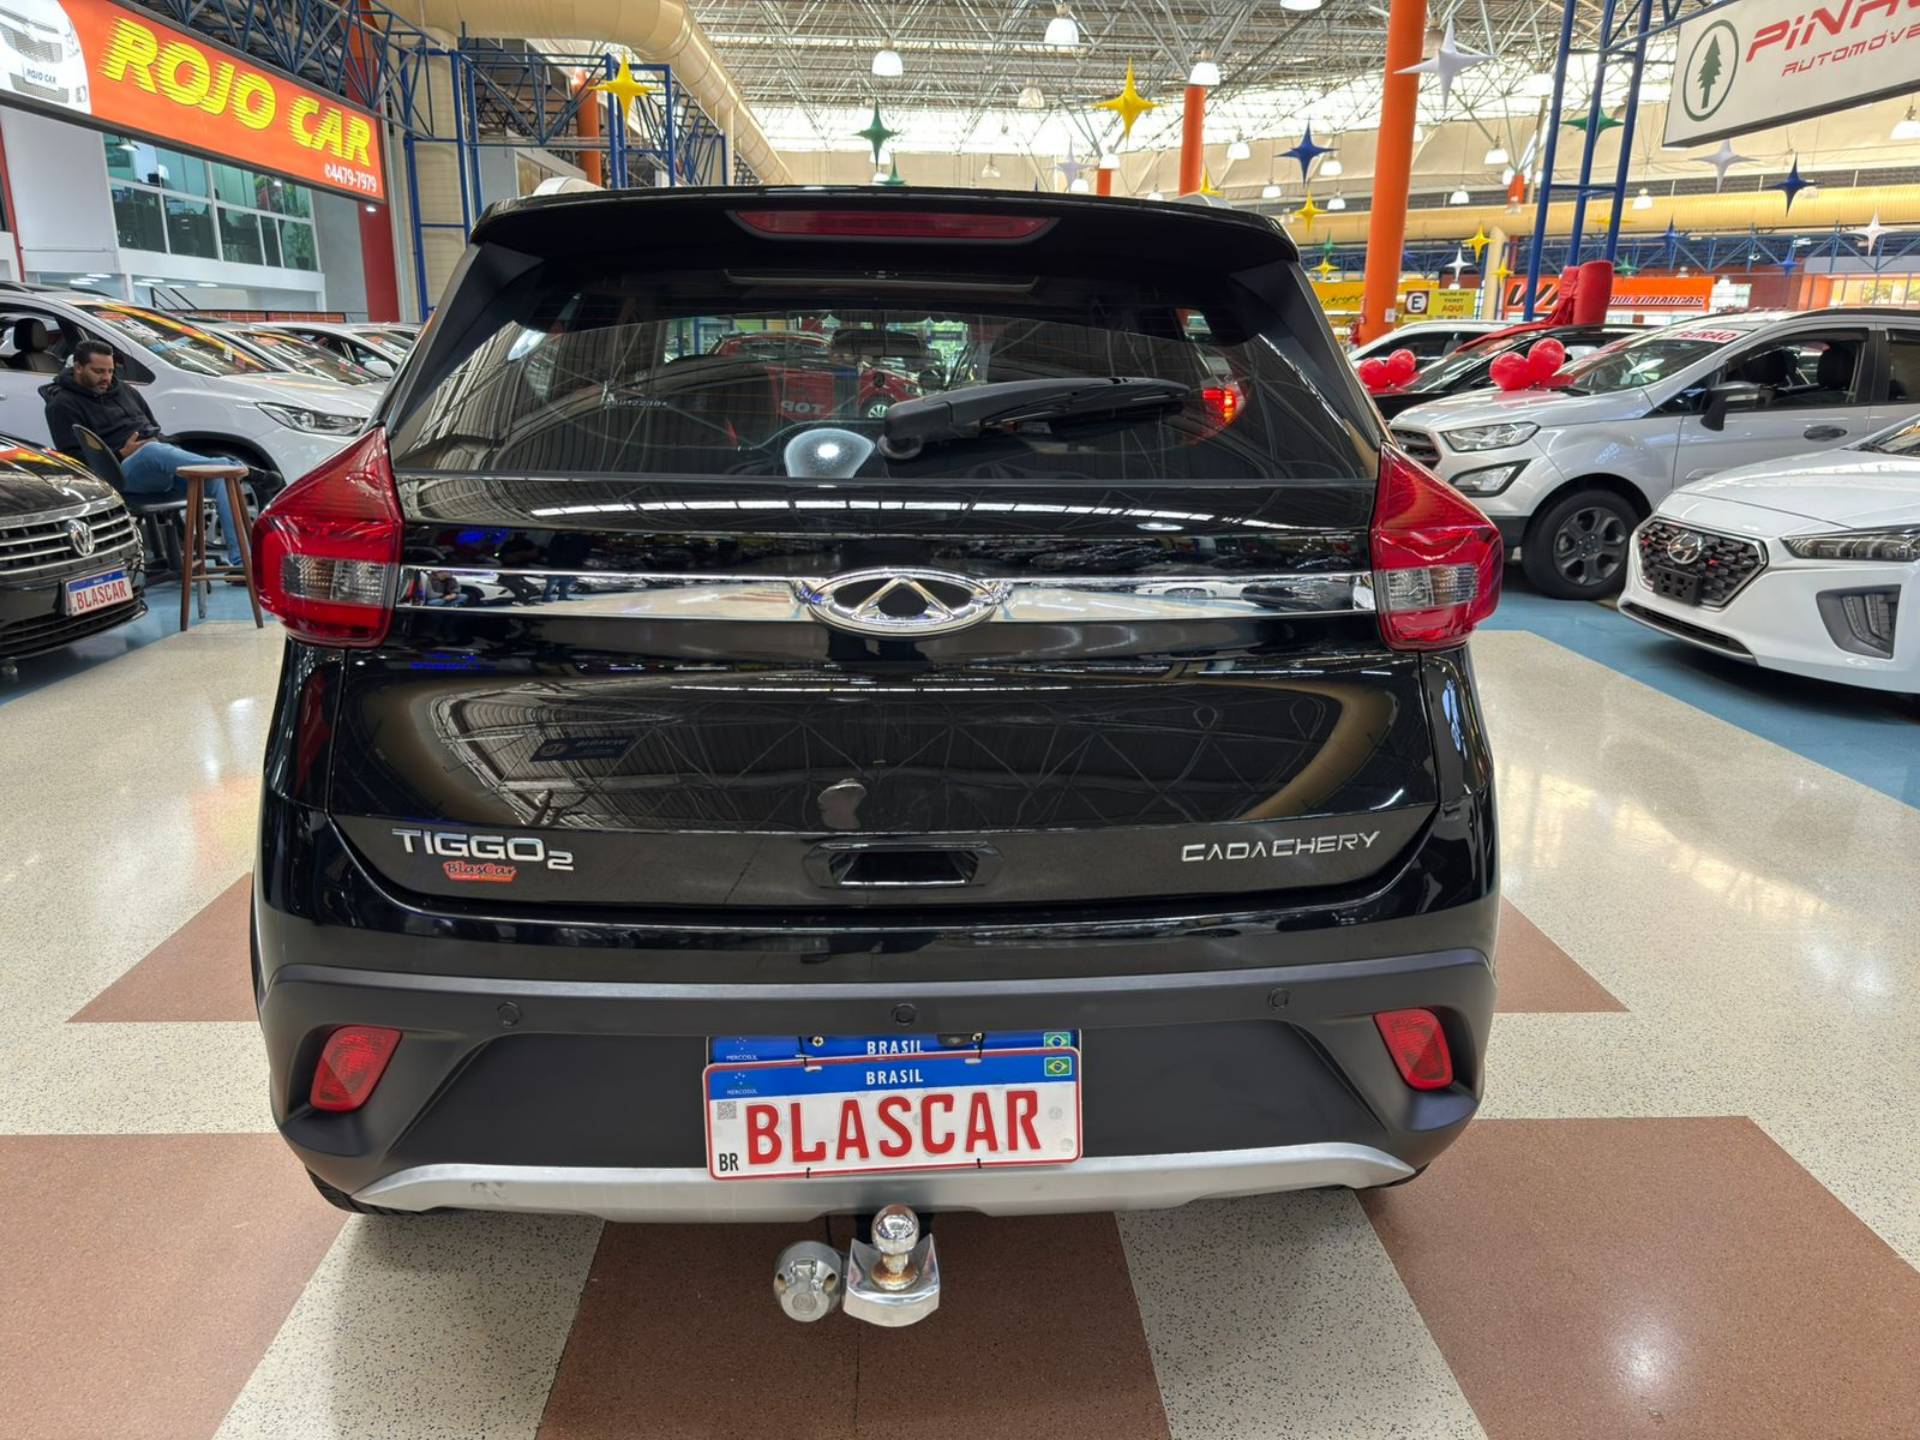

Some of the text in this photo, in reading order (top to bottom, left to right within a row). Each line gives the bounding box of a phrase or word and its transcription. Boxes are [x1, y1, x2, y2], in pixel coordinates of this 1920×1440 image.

[99, 16, 371, 167] ROJO CAR
[1411, 296, 1422, 310] E
[1441, 304, 1464, 312] AQUI
[76, 581, 127, 609] BLASCAR
[867, 1040, 925, 1055] BRASIL
[865, 1069, 924, 1086] BRASIL
[746, 1090, 1041, 1165] BLASCAR
[718, 1153, 739, 1172] BR
